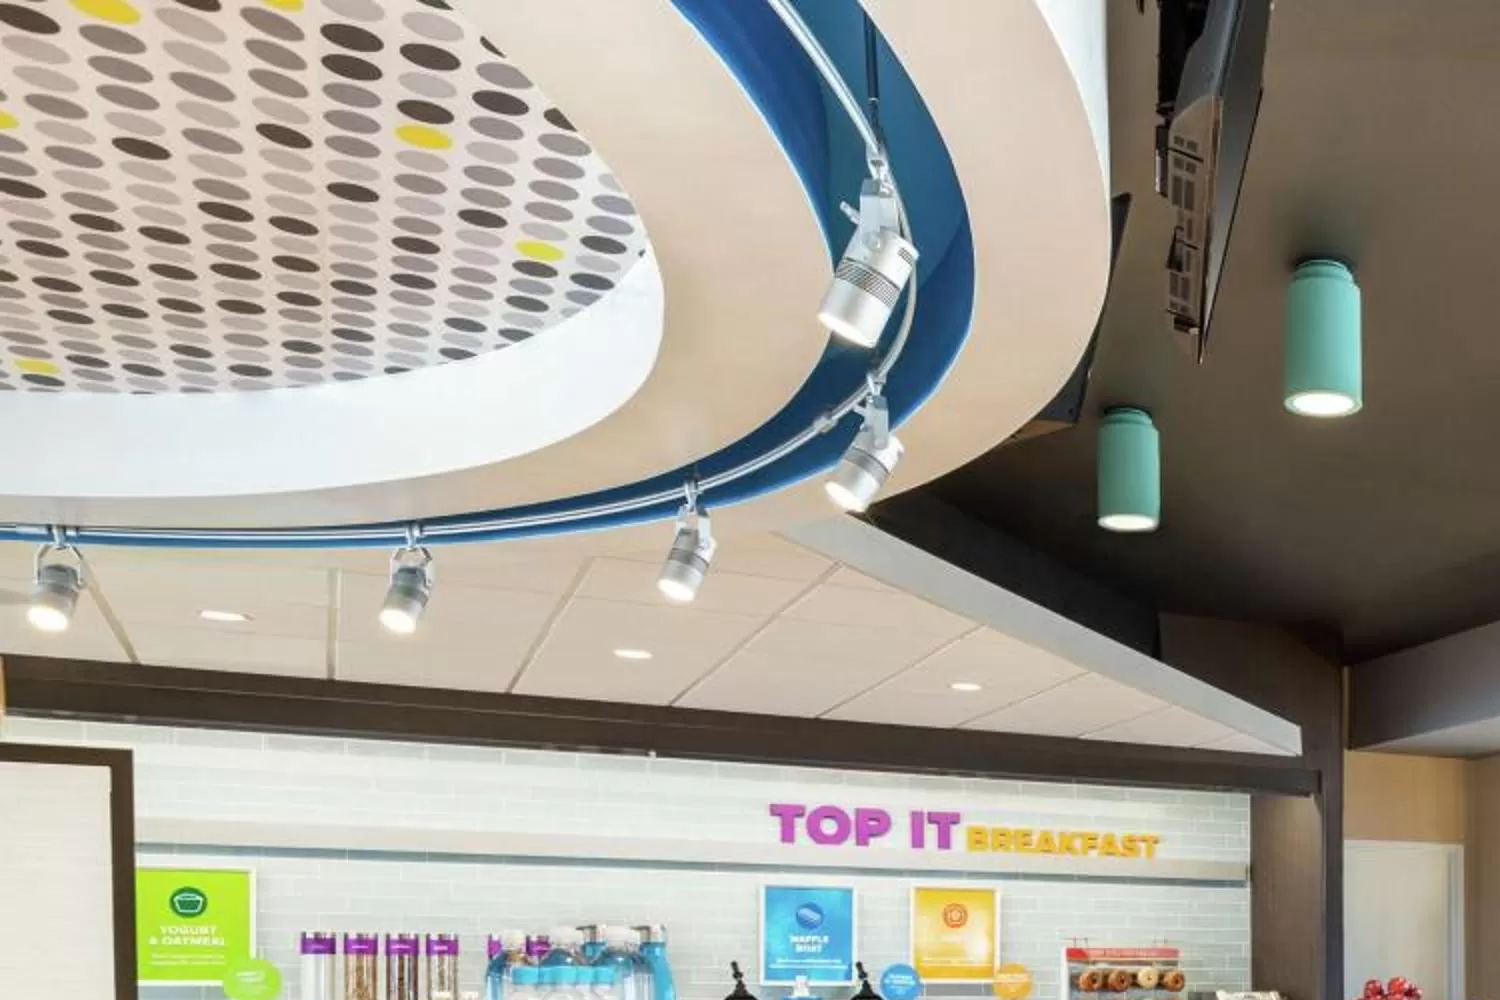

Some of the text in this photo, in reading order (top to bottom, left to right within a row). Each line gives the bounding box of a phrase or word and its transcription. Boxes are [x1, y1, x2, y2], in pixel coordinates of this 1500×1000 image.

[769, 803, 1161, 859] TOP IT BREAKFAST
[160, 925, 217, 935] YOGURT
